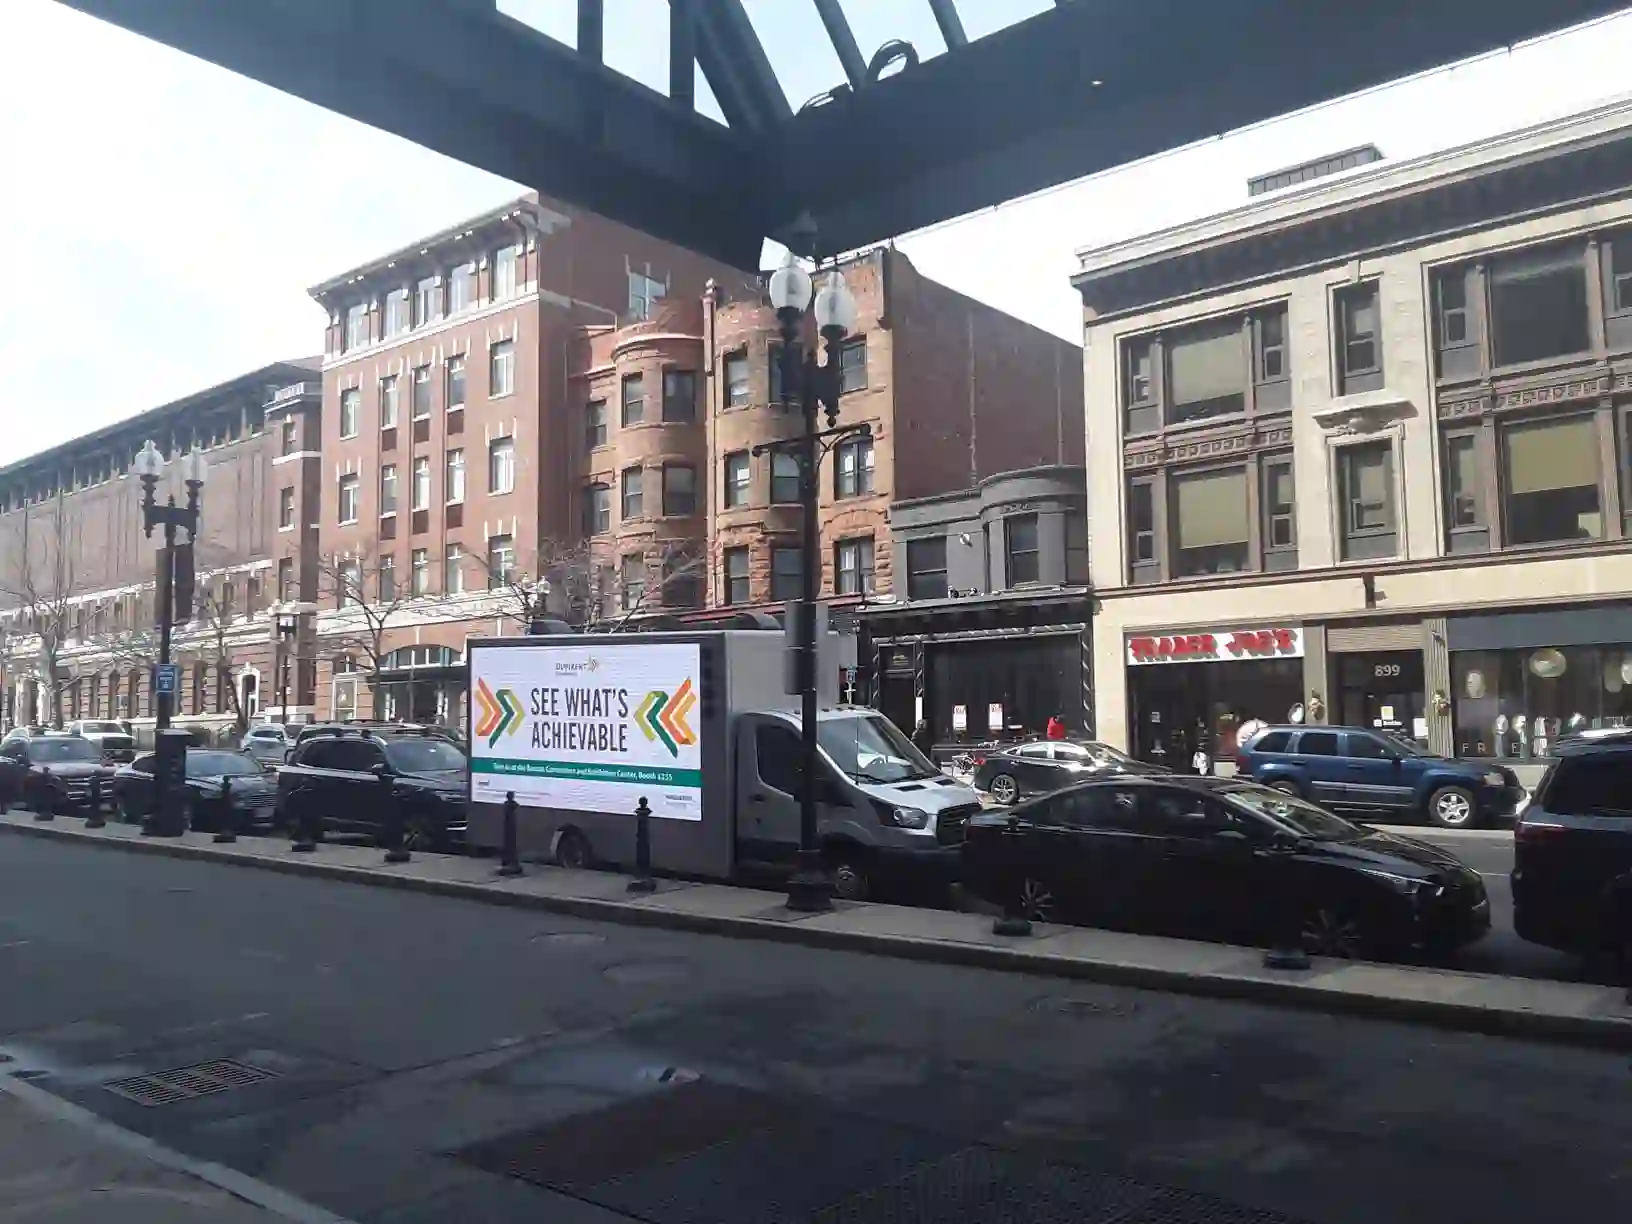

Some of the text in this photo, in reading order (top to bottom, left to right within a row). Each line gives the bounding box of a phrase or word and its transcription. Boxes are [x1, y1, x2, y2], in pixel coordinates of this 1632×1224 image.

[1374, 664, 1401, 677] 899
[531, 687, 628, 718] SEE WHAT'S
[531, 721, 628, 752] ACHIEVABLE
